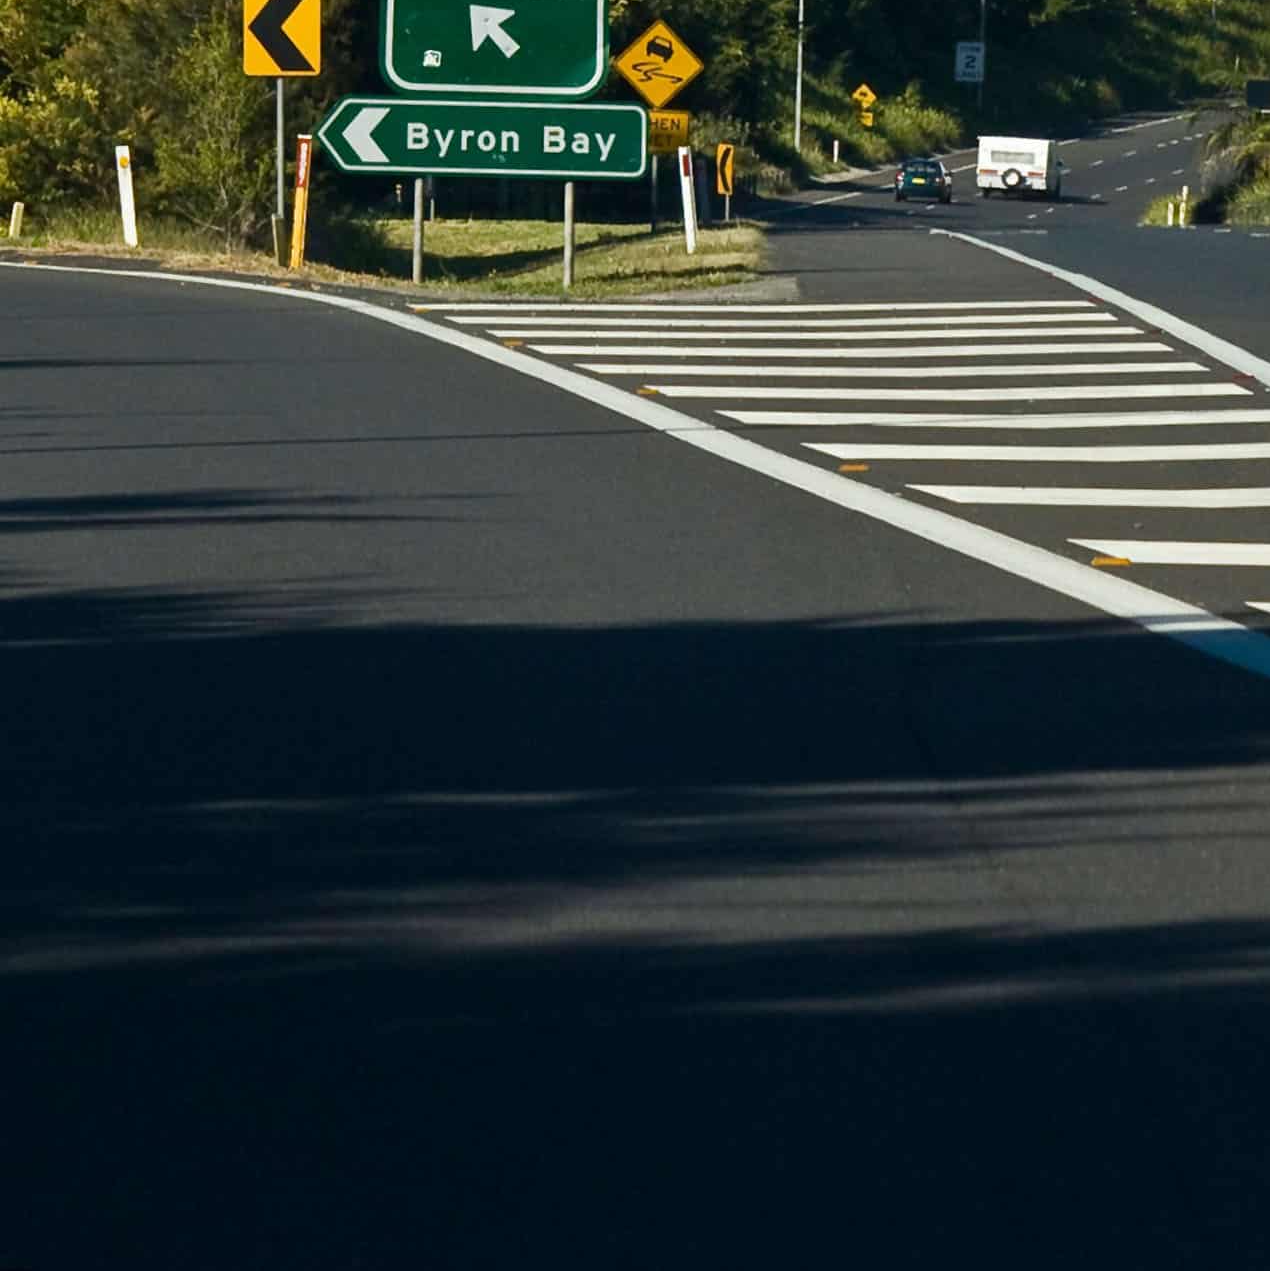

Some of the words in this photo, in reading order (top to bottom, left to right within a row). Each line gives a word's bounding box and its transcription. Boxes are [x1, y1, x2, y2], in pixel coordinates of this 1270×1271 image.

[650, 117, 681, 131] HEN
[407, 122, 520, 158] Byron
[543, 125, 616, 162] Bay
